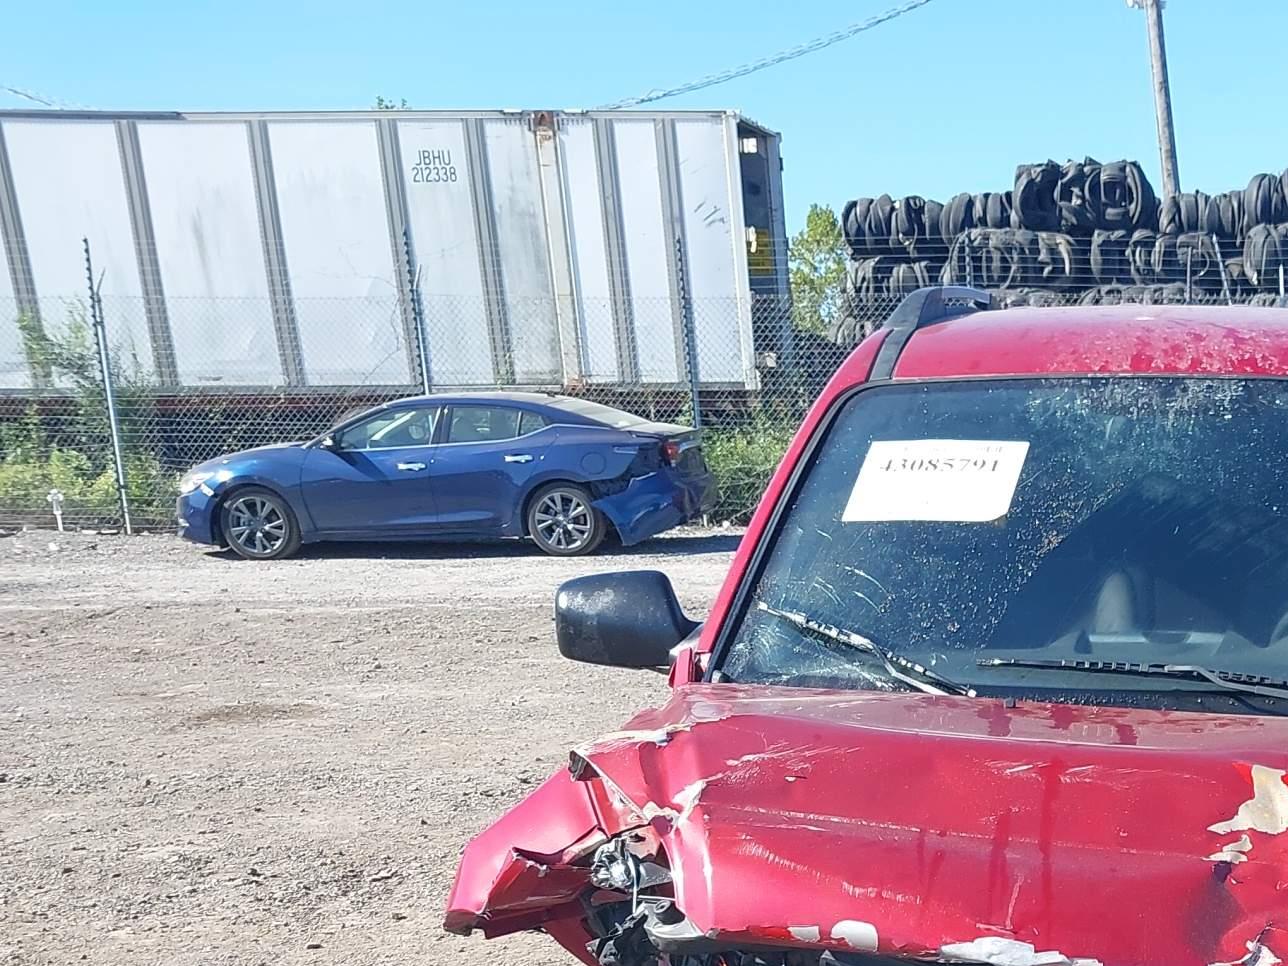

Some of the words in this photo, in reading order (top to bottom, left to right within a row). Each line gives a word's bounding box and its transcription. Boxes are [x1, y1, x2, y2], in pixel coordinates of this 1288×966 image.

[416, 150, 451, 166] JBHU
[412, 167, 457, 183] 212338
[880, 458, 999, 472] 43085791
